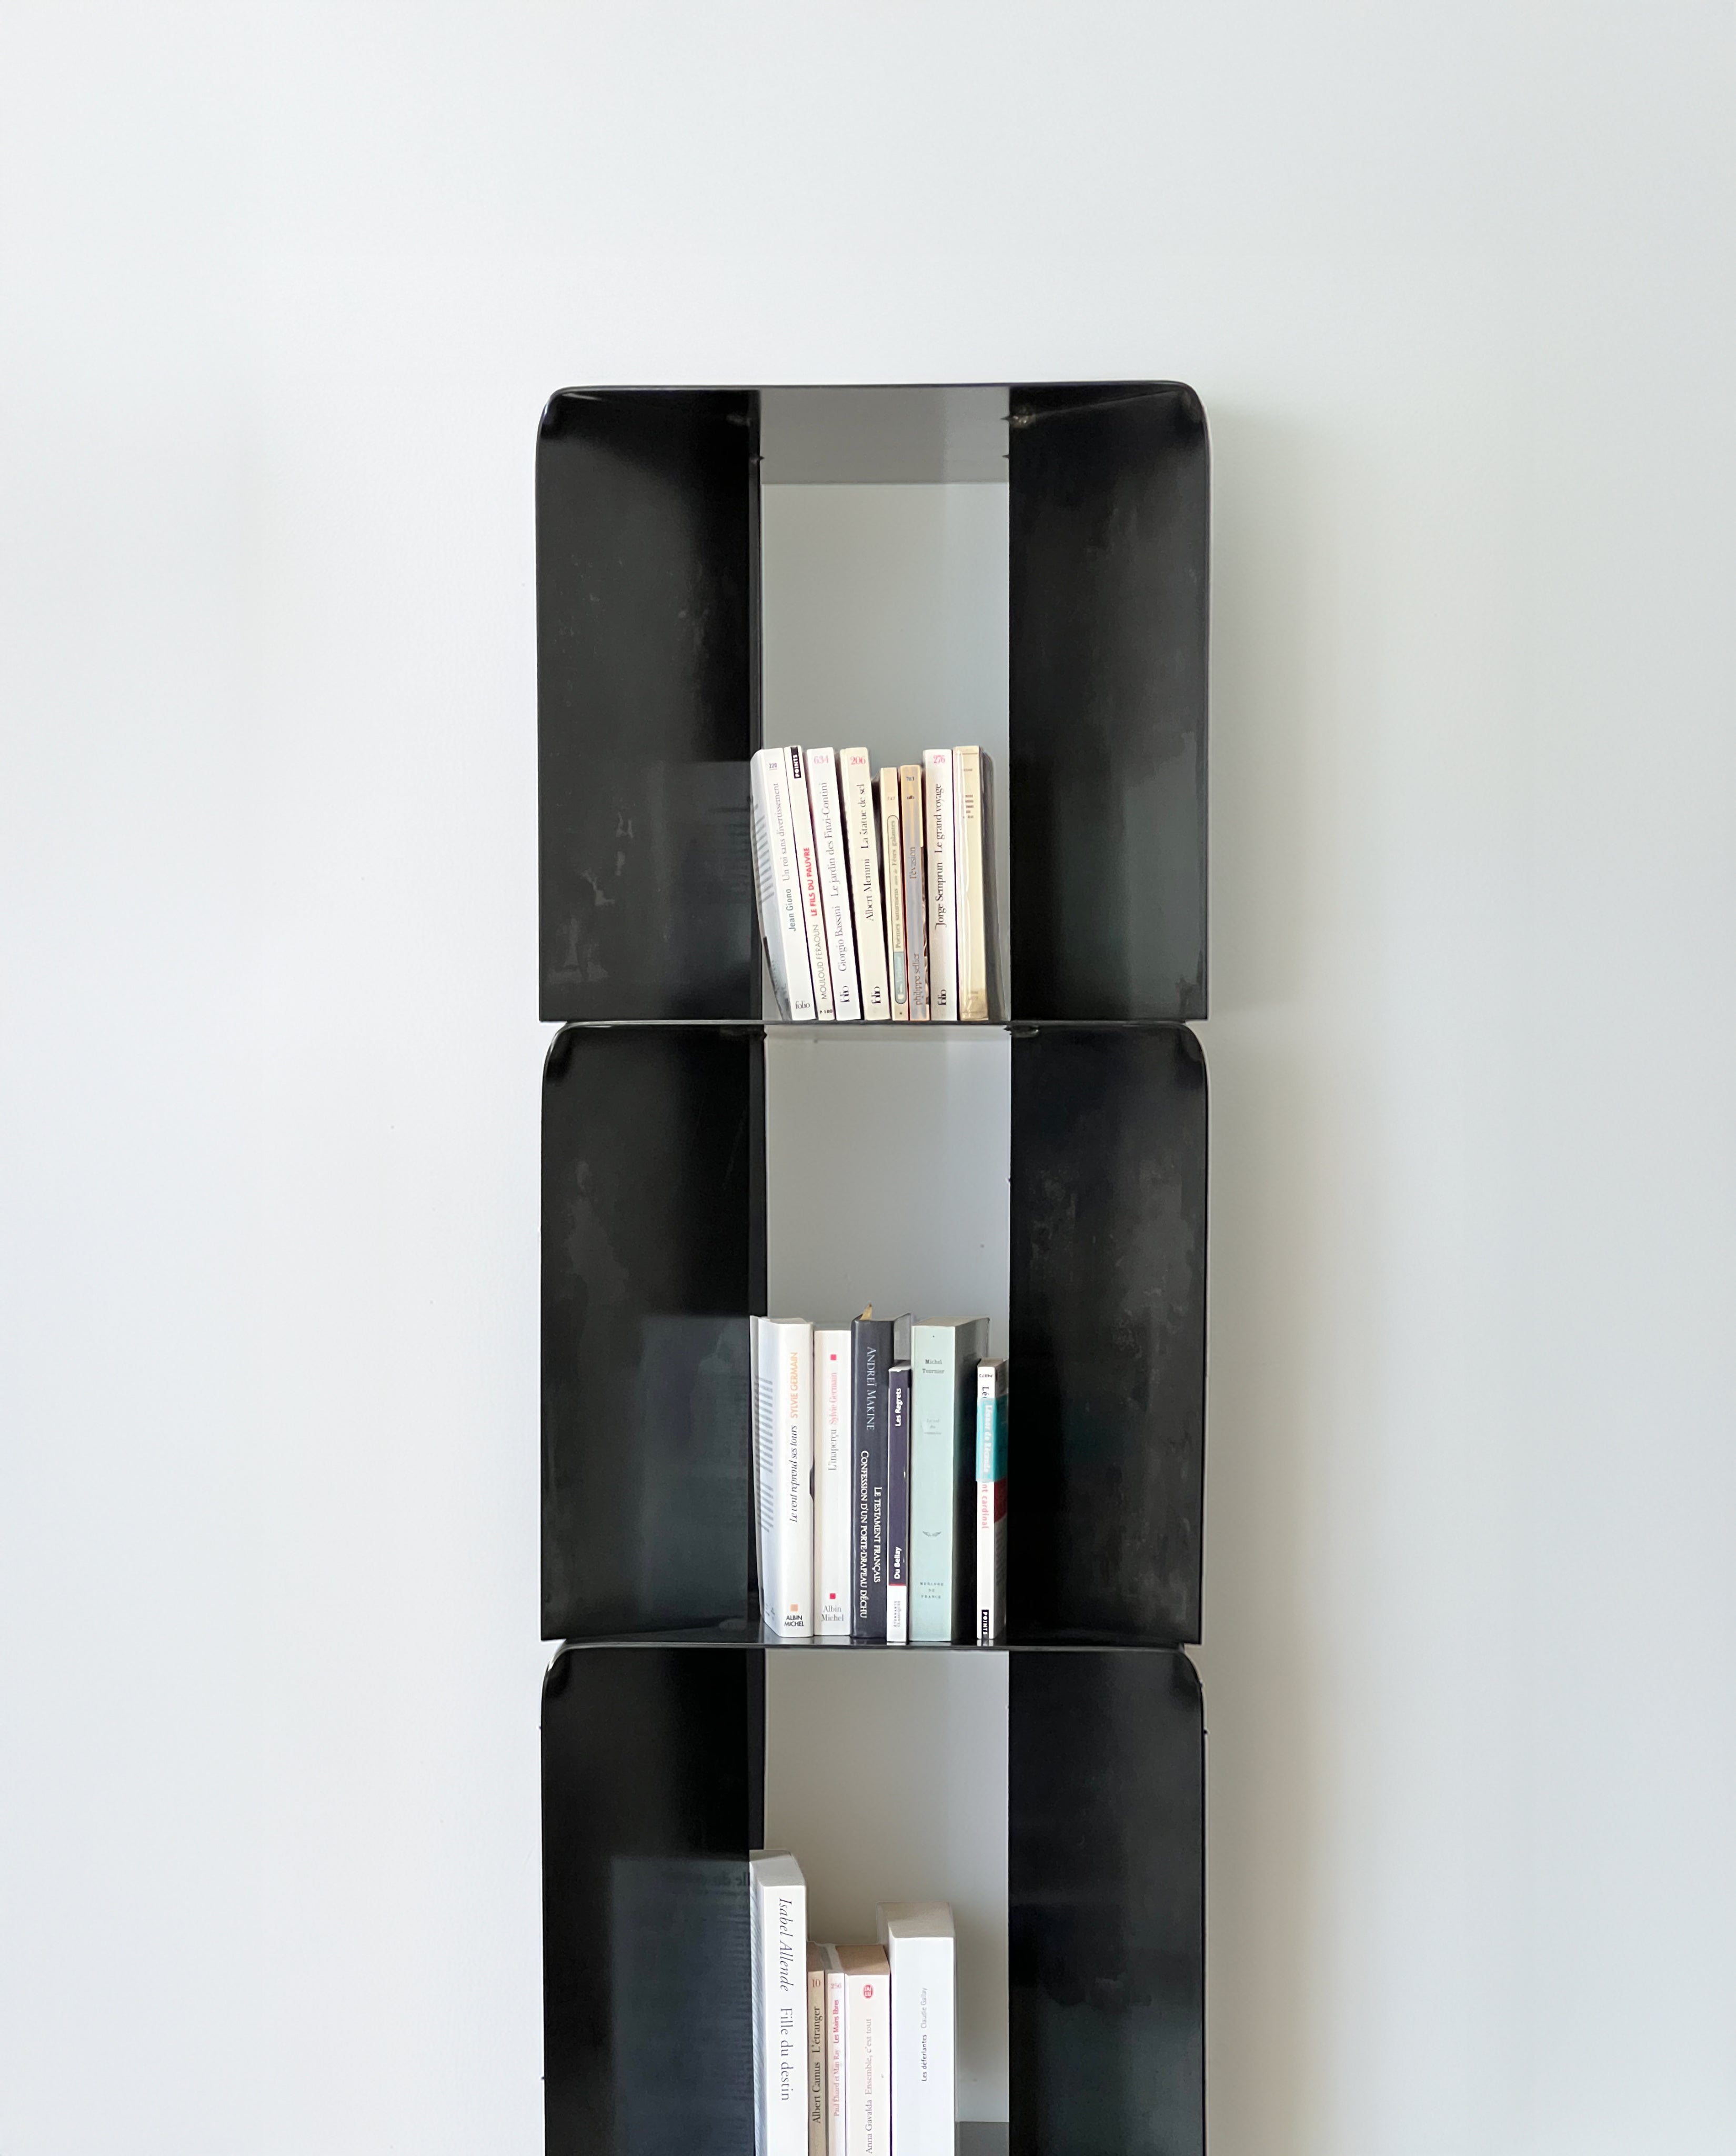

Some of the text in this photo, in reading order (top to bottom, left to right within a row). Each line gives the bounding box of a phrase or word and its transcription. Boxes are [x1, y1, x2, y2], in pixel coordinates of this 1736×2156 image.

[814, 755, 829, 765] 634
[850, 756, 866, 765] 206
[933, 754, 945, 764] 276
[773, 783, 785, 836] divertissement
[819, 782, 832, 839] Finzi-Contini
[857, 796, 866, 808] de
[859, 810, 868, 837] statue
[934, 783, 945, 853] Le grand voyage
[861, 837, 869, 849] La
[782, 869, 790, 881] Un
[803, 847, 812, 877] PAUVRE
[828, 857, 840, 884] jardin
[807, 879, 814, 890] DU
[831, 884, 839, 896] Le
[862, 858, 874, 921] Albert Memmi
[935, 862, 947, 930] Jorge Semprun
[831, 905, 848, 972] Giorgio Bassani
[812, 924, 827, 1000] MOULOUD FERAOUN
[912, 954, 924, 1005] philippe sellier
[795, 1001, 810, 1010] folio
[840, 985, 850, 1003] folio
[871, 986, 881, 1004] folio
[938, 989, 947, 1005] folio
[829, 1404, 839, 1425] Sylvie
[866, 1390, 876, 1431] MAKINE
[828, 1430, 839, 1470] L'inaperçu
[789, 1460, 800, 1493] reprend
[860, 1450, 869, 1501] CONFESSION
[874, 1487, 882, 1497] LE
[789, 1513, 797, 1522] Le
[860, 1503, 869, 1523] D'UN
[872, 1545, 881, 1583] FRANÇAIS
[894, 1569, 900, 1579] Du
[860, 1590, 869, 1618] DÉCHU
[779, 1898, 794, 1991] Isabel Allende
[812, 2007, 823, 2053] L'étranger
[780, 2008, 794, 2100] Fille du destin
[812, 2062, 821, 2124] Albert Camus
